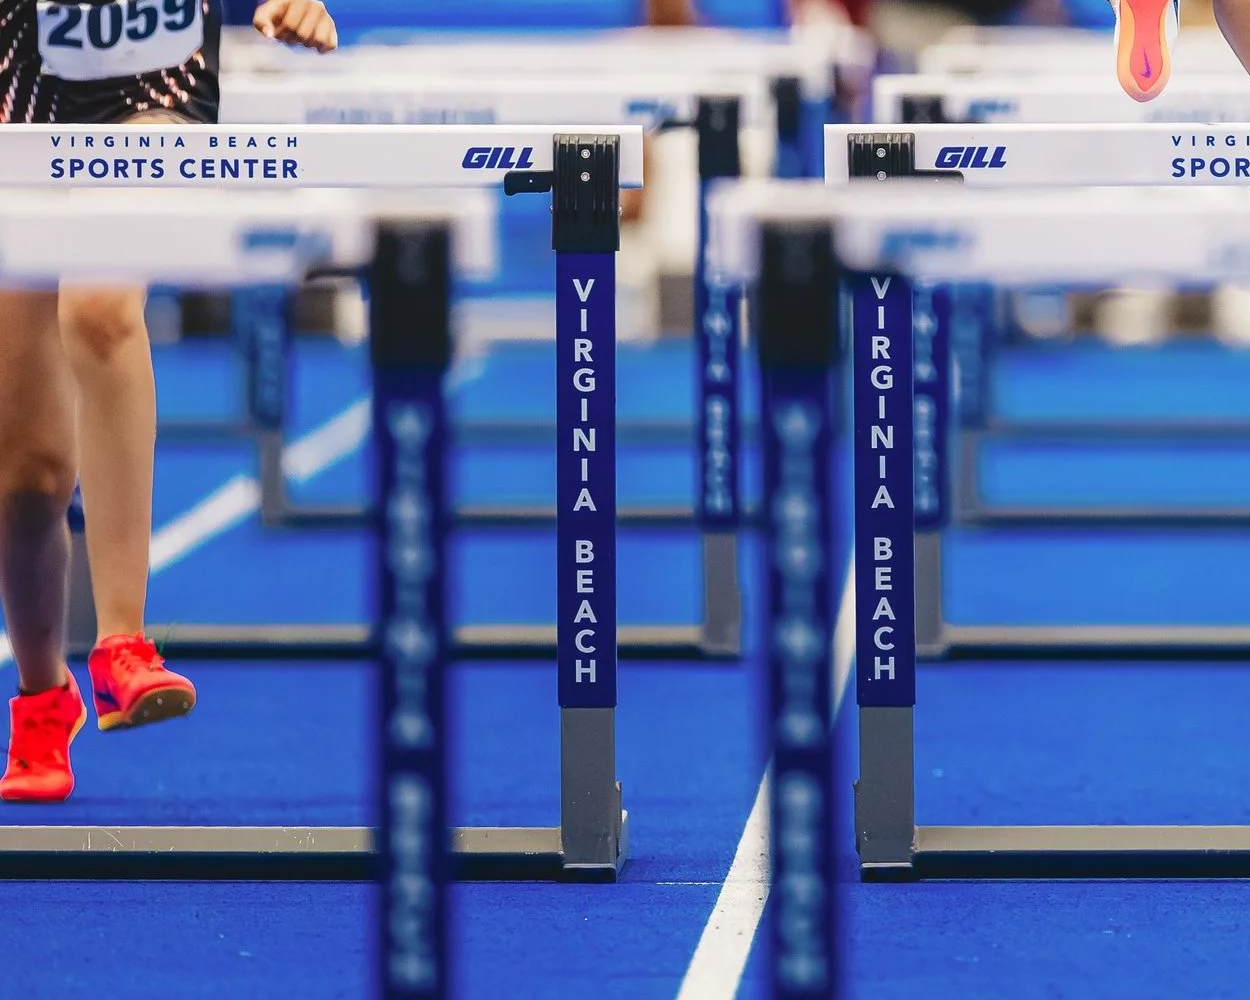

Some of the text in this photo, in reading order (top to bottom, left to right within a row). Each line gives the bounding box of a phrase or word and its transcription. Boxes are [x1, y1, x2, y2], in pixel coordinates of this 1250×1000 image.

[50, 135, 298, 148] VIRGINIA BEACH
[50, 158, 299, 179] SPORTS CENTER
[461, 146, 534, 169] GILL
[934, 146, 1007, 169] GILL
[572, 278, 598, 683] VIRGINIA BEACH
[870, 276, 896, 681] VIRGINIA BEACH
